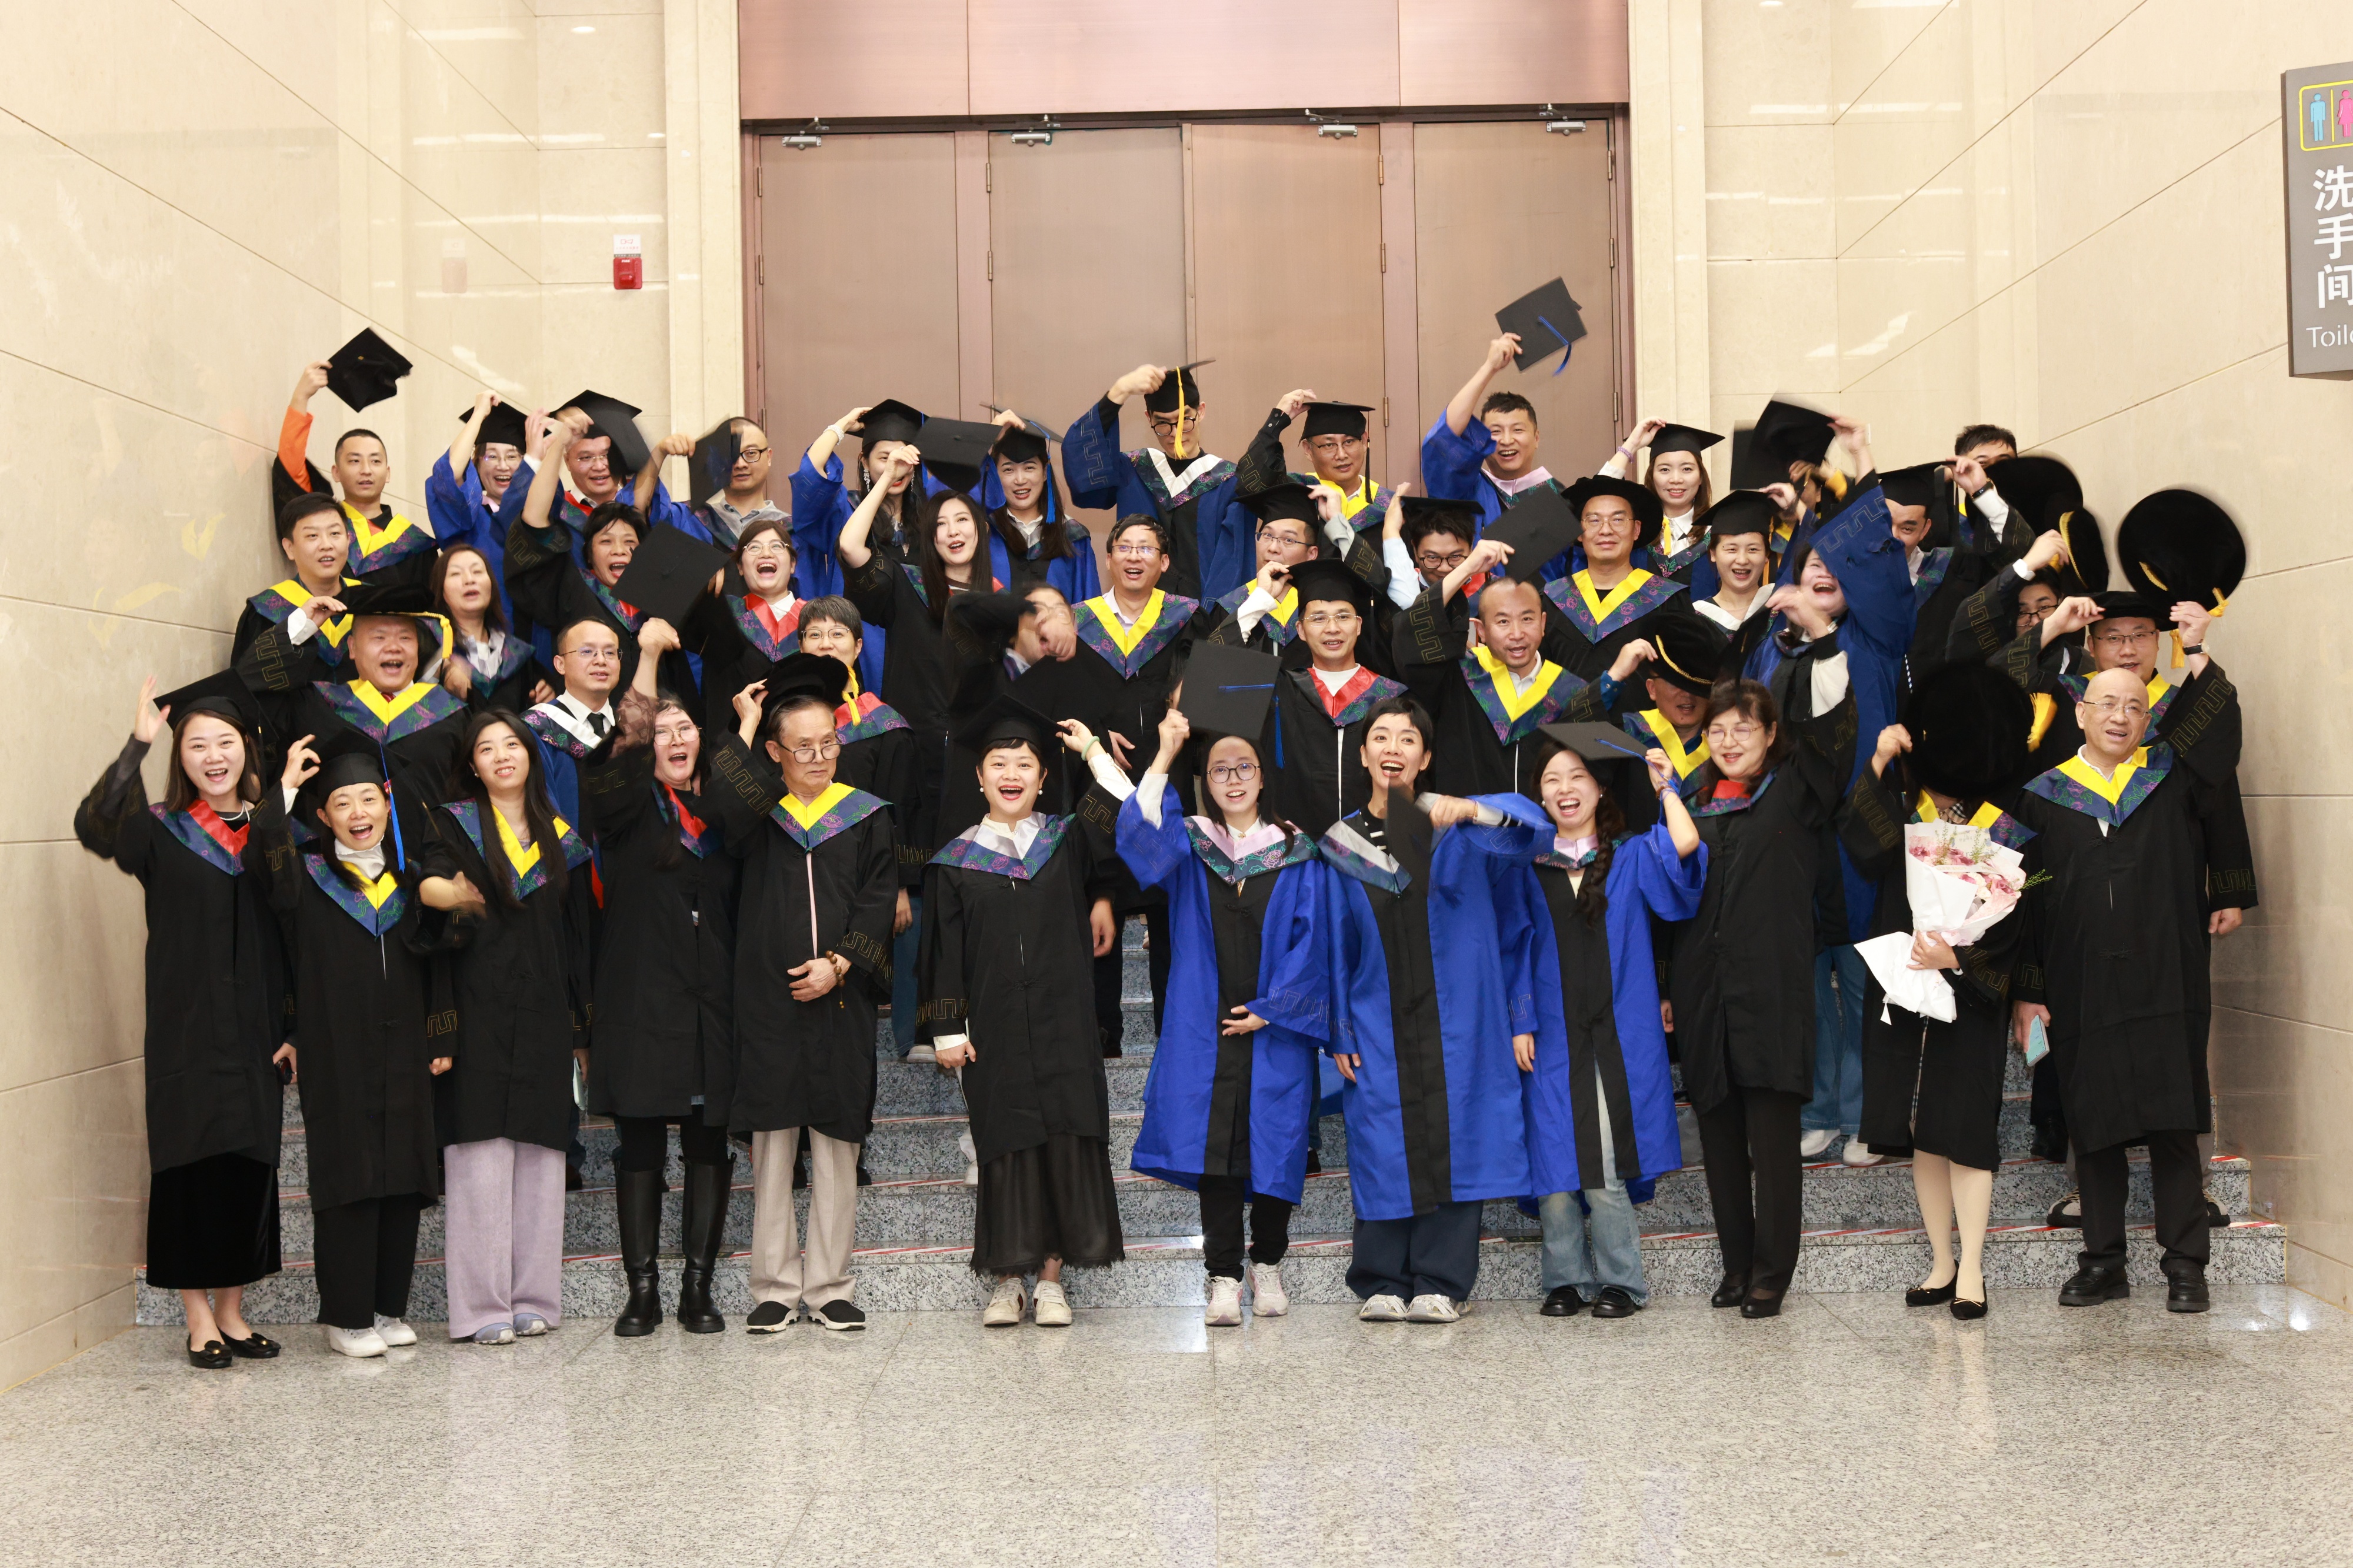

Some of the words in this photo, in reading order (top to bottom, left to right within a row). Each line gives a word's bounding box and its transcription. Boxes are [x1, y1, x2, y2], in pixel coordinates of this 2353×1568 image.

[2312, 165, 2353, 309] 洗手间
[2305, 323, 2353, 348] Toil
